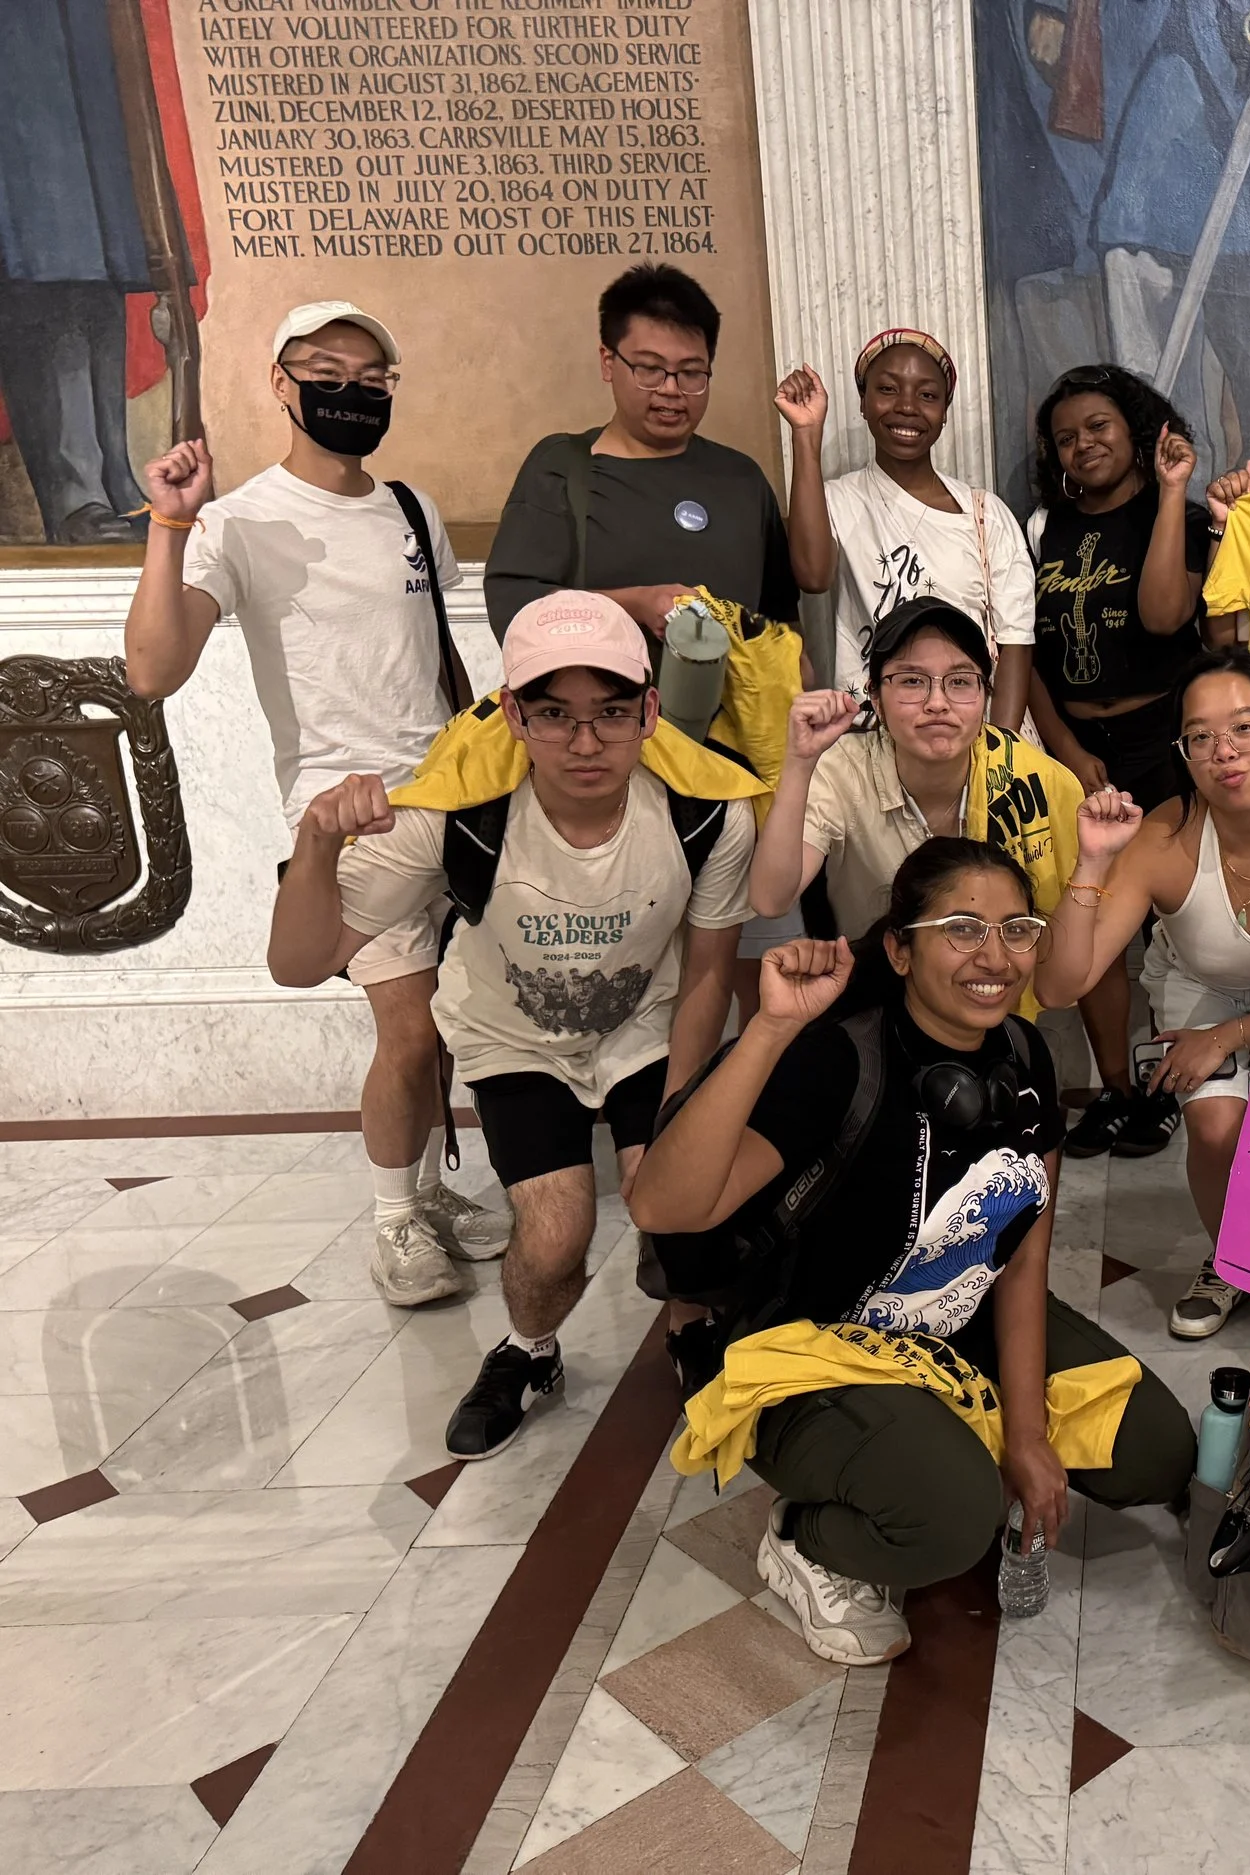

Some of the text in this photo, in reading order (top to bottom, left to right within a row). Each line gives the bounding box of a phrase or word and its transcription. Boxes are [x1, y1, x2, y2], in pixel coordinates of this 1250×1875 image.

[200, 15, 691, 41] IATELY VOLUNTEERED FOR FURTHER DUTY
[203, 43, 701, 68] WITH OTHER ORGANIZATIONS. SECOND SERVICE
[208, 73, 323, 96] MUSTERED
[330, 73, 349, 95] IN
[359, 73, 445, 94] AUGUST
[278, 100, 408, 122] DECEMBER
[511, 98, 615, 121] DESERTED
[621, 98, 701, 120] HOUSE
[216, 129, 318, 150] JANUARY
[419, 126, 552, 149] CARRSVILLE
[559, 125, 609, 148] MAY
[219, 156, 343, 177] MUSTERED
[356, 155, 404, 177] OUT
[414, 154, 470, 175] JUNE
[549, 153, 612, 175] THIRD
[620, 152, 710, 174] SERVICE.
[224, 181, 350, 204] MUSTERED
[358, 180, 380, 203] IN
[393, 180, 446, 203] JULY
[563, 179, 597, 201] ON
[606, 178, 672, 201] DUTY
[680, 178, 708, 200] AT
[228, 209, 295, 231] FORT
[308, 207, 449, 231] DELAWARE
[459, 207, 532, 230] MOST
[542, 207, 574, 229] OF
[584, 206, 634, 228] THIS
[232, 235, 305, 258] MENT.
[312, 234, 443, 257] MUSTERED
[454, 233, 506, 256] OUT
[518, 233, 624, 256] OCTOBER
[1101, 607, 1128, 619] Since
[517, 910, 632, 931] CYC YOUTH
[523, 929, 624, 946] LEADERS
[915, 1155, 924, 1173] WAY
[914, 1178, 921, 1188] TO
[909, 1192, 920, 1228] SURVIVE
